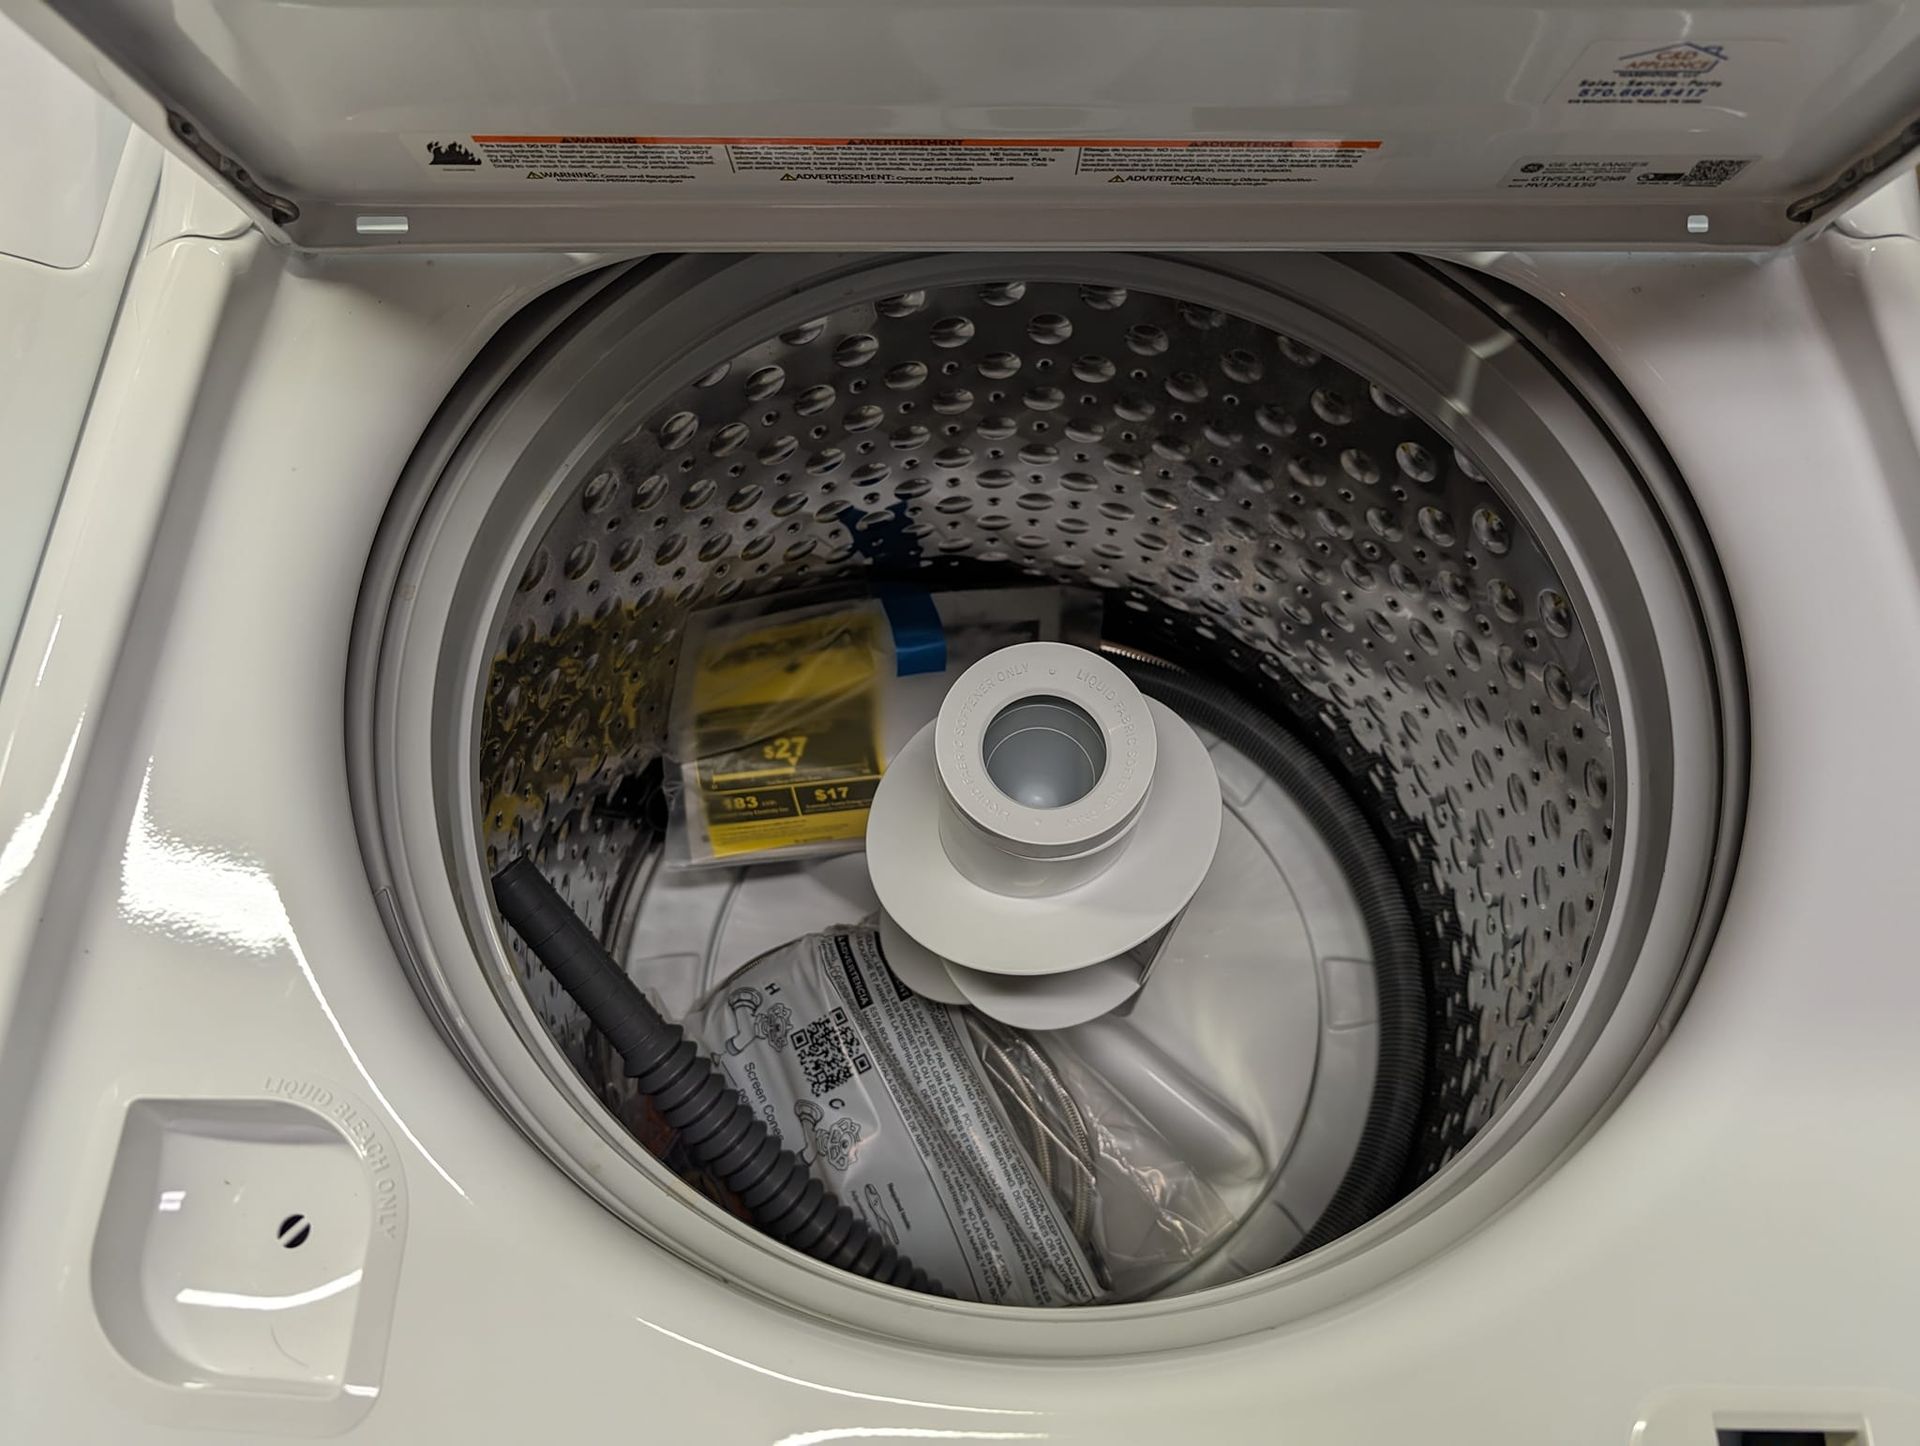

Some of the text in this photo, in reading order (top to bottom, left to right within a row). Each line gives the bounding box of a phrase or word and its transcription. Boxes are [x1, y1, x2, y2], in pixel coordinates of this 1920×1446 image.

[796, 173, 895, 181] ADVERTISSEMENT:
[1124, 174, 1204, 182] ADVERTENCIA:
[1076, 667, 1116, 701] LIQUID
[955, 678, 996, 738] SOFTENER
[996, 662, 1032, 683] ONLY
[763, 736, 808, 760] $27
[834, 939, 872, 1005] ADVERTENCIA
[764, 981, 781, 996] H
[909, 996, 920, 1012] CE
[868, 1005, 883, 1027] ESTA
[889, 1019, 900, 1032] LA
[914, 1010, 928, 1029] SAC
[888, 996, 901, 1013] LES
[919, 1065, 931, 1080] OU
[925, 1078, 938, 1096] LES
[901, 1001, 920, 1034] GARDEZ
[915, 1034, 927, 1049] CE
[921, 1047, 935, 1066] SAC
[929, 1065, 943, 1086] LOIN
[938, 1085, 951, 1104] DES
[894, 1030, 924, 1086] RESPIRATION.
[933, 1051, 947, 1069] PAS
[740, 1061, 770, 1105] Screen
[941, 1067, 952, 1082] UN
[828, 1098, 846, 1111] C
[949, 1051, 967, 1082] MOUTH
[962, 1082, 976, 1102] AND
[971, 1100, 993, 1139] PREVENT
[889, 1082, 913, 1122] DESPUÉS
[907, 1120, 919, 1134] DE
[264, 1075, 398, 1240] LIQUID BLEACH ONLY
[965, 1206, 977, 1221] NO
[971, 1220, 981, 1233] LA
[975, 1232, 989, 1252] USE
